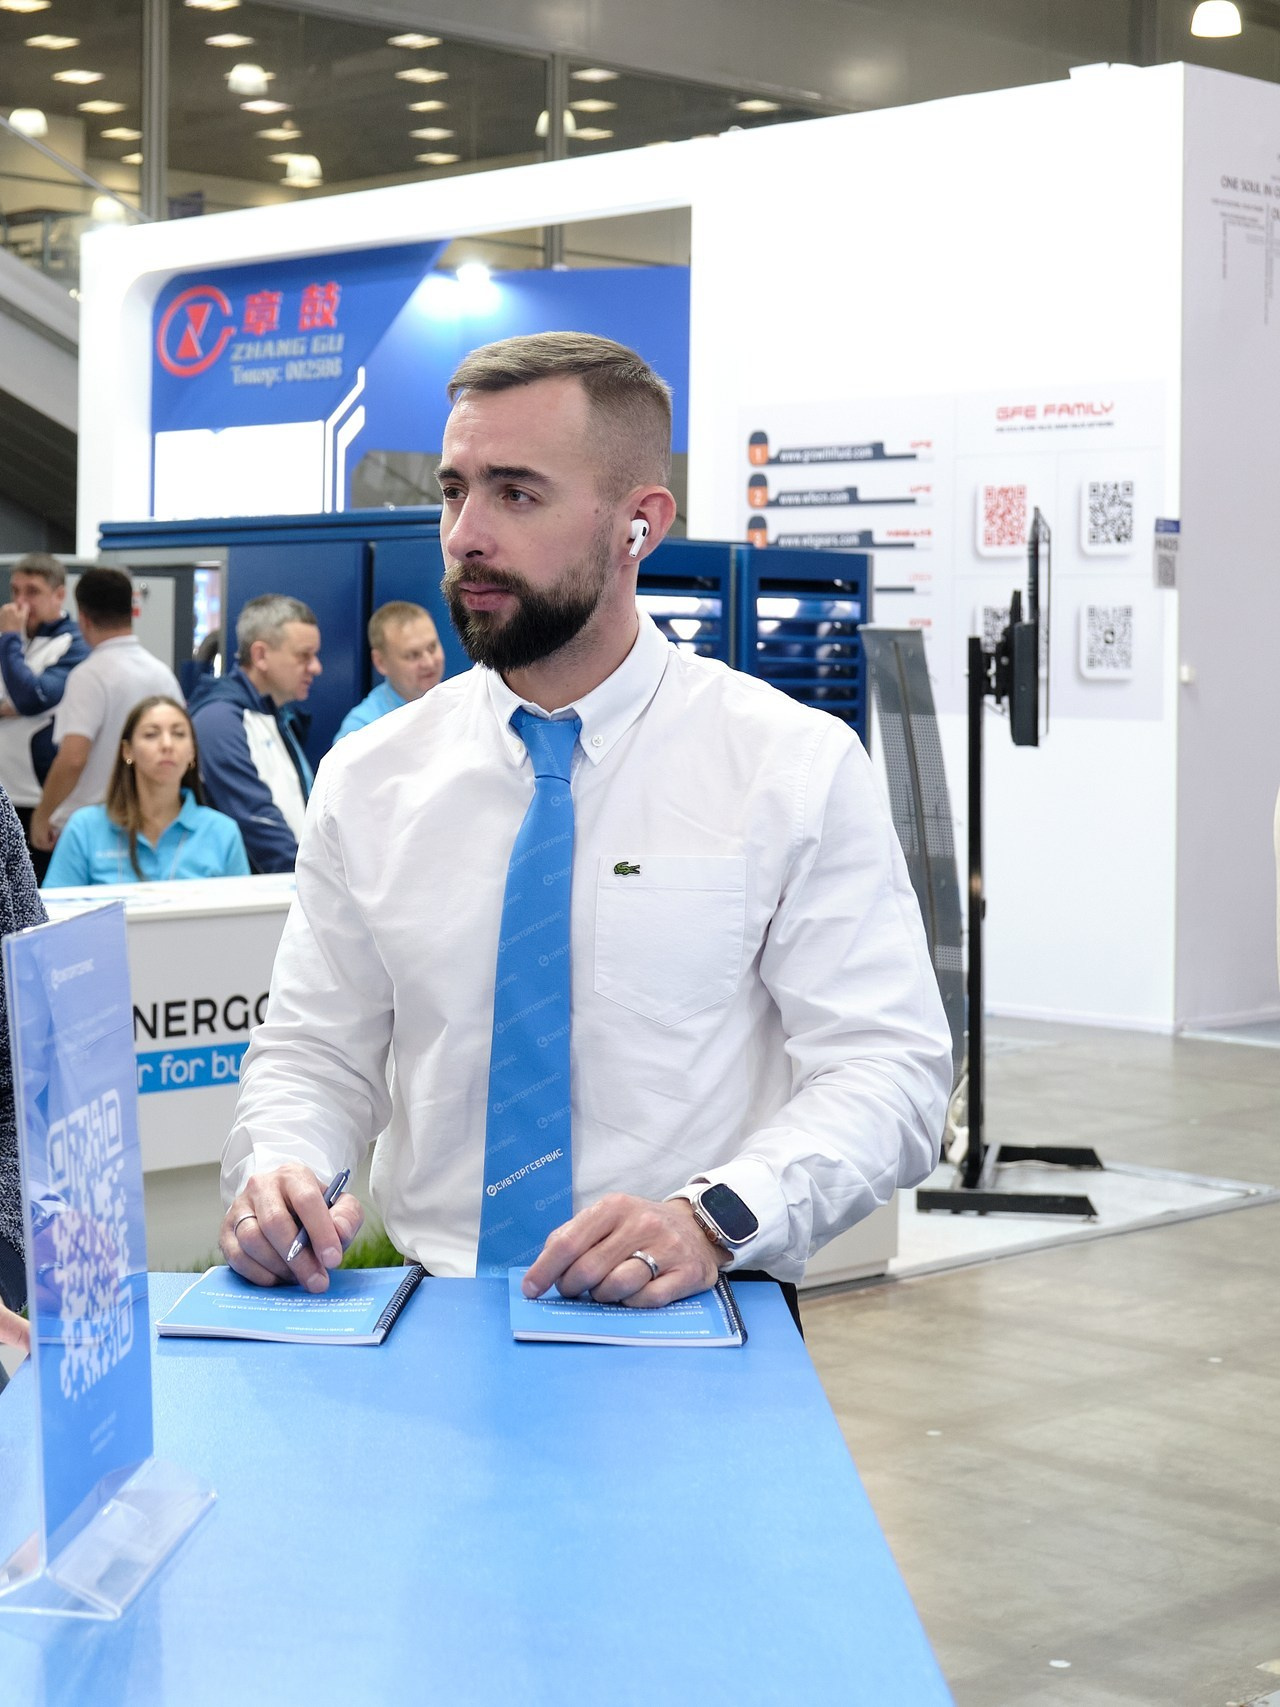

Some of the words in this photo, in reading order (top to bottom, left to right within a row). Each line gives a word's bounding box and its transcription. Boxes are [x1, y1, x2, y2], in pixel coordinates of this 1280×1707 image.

[231, 337, 307, 362] ZHANG
[311, 333, 344, 354] GU
[1043, 401, 1114, 417] FAMILY
[159, 1054, 205, 1085] for
[496, 1148, 564, 1190] СИБТОРГСЕРВИС
